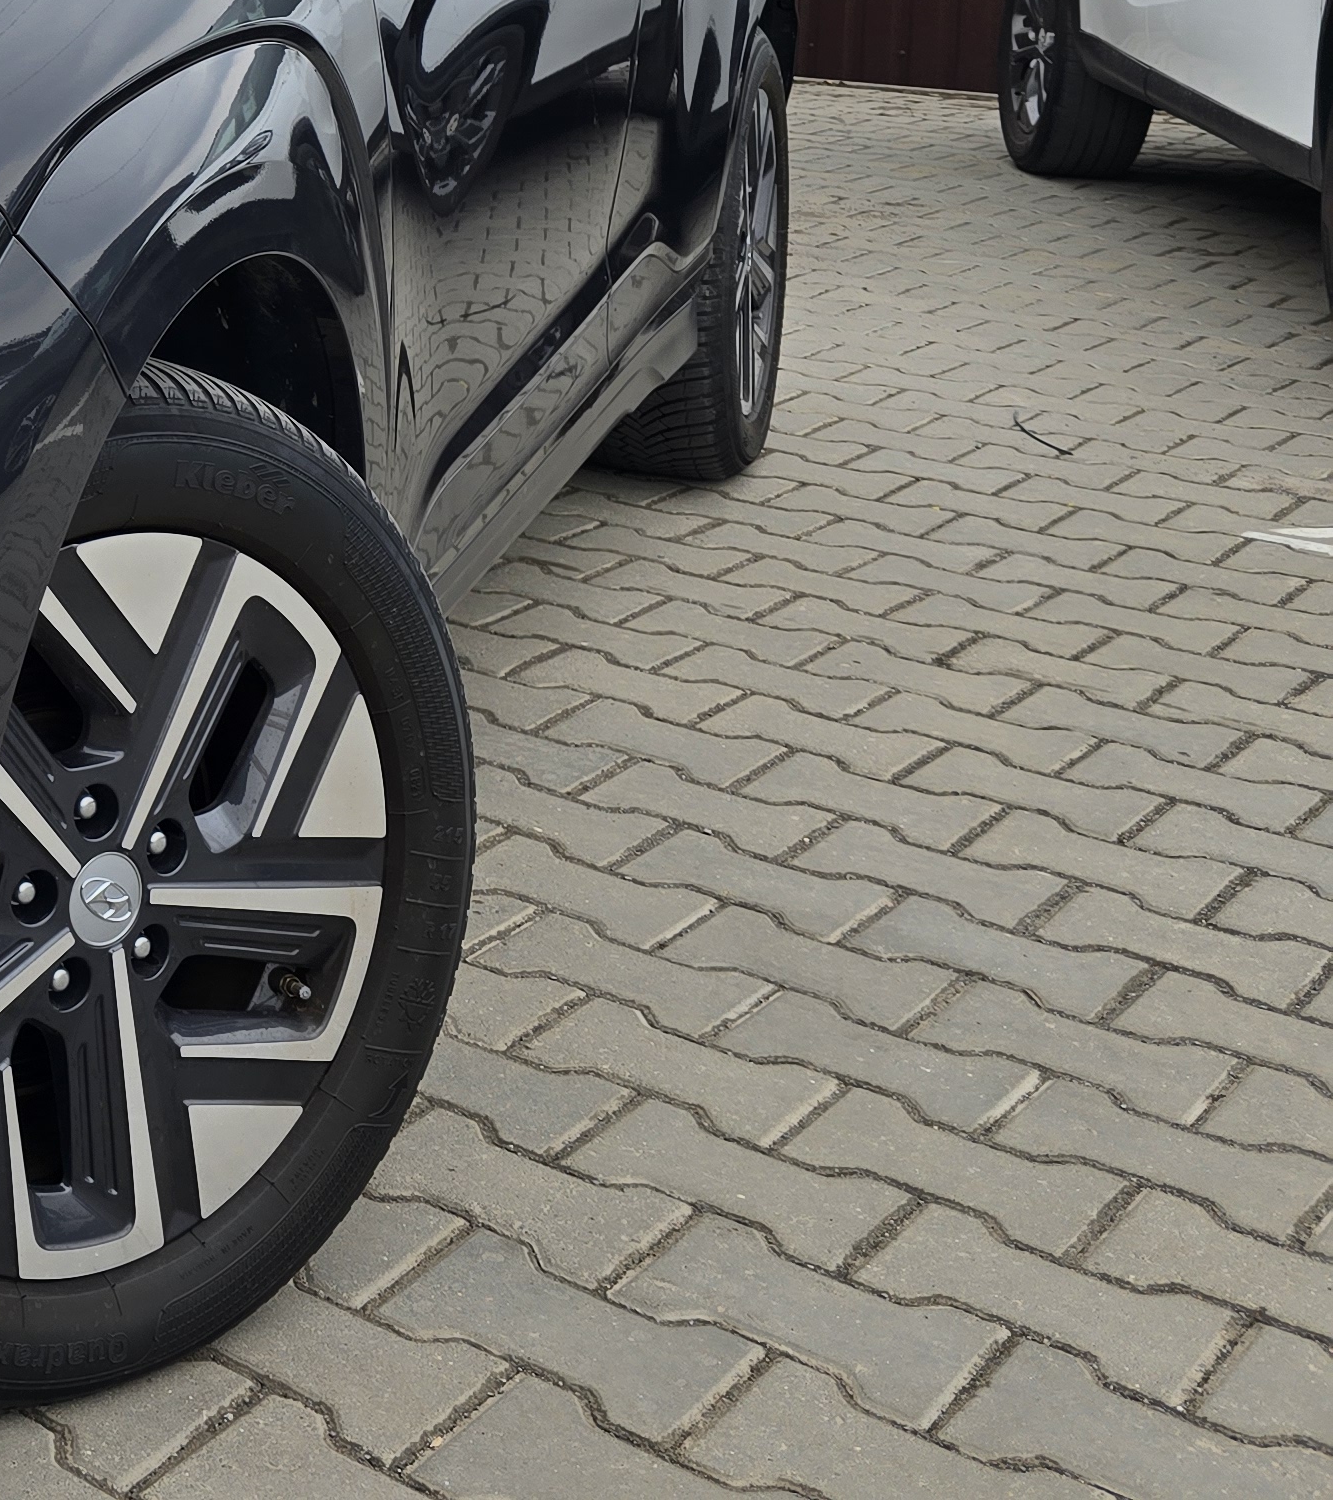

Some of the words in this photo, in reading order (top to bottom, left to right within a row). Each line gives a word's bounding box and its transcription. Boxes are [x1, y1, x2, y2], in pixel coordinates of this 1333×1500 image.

[173, 459, 296, 516] Kleber
[433, 825, 464, 845] 215
[430, 873, 452, 892] 55
[440, 922, 458, 940] 17
